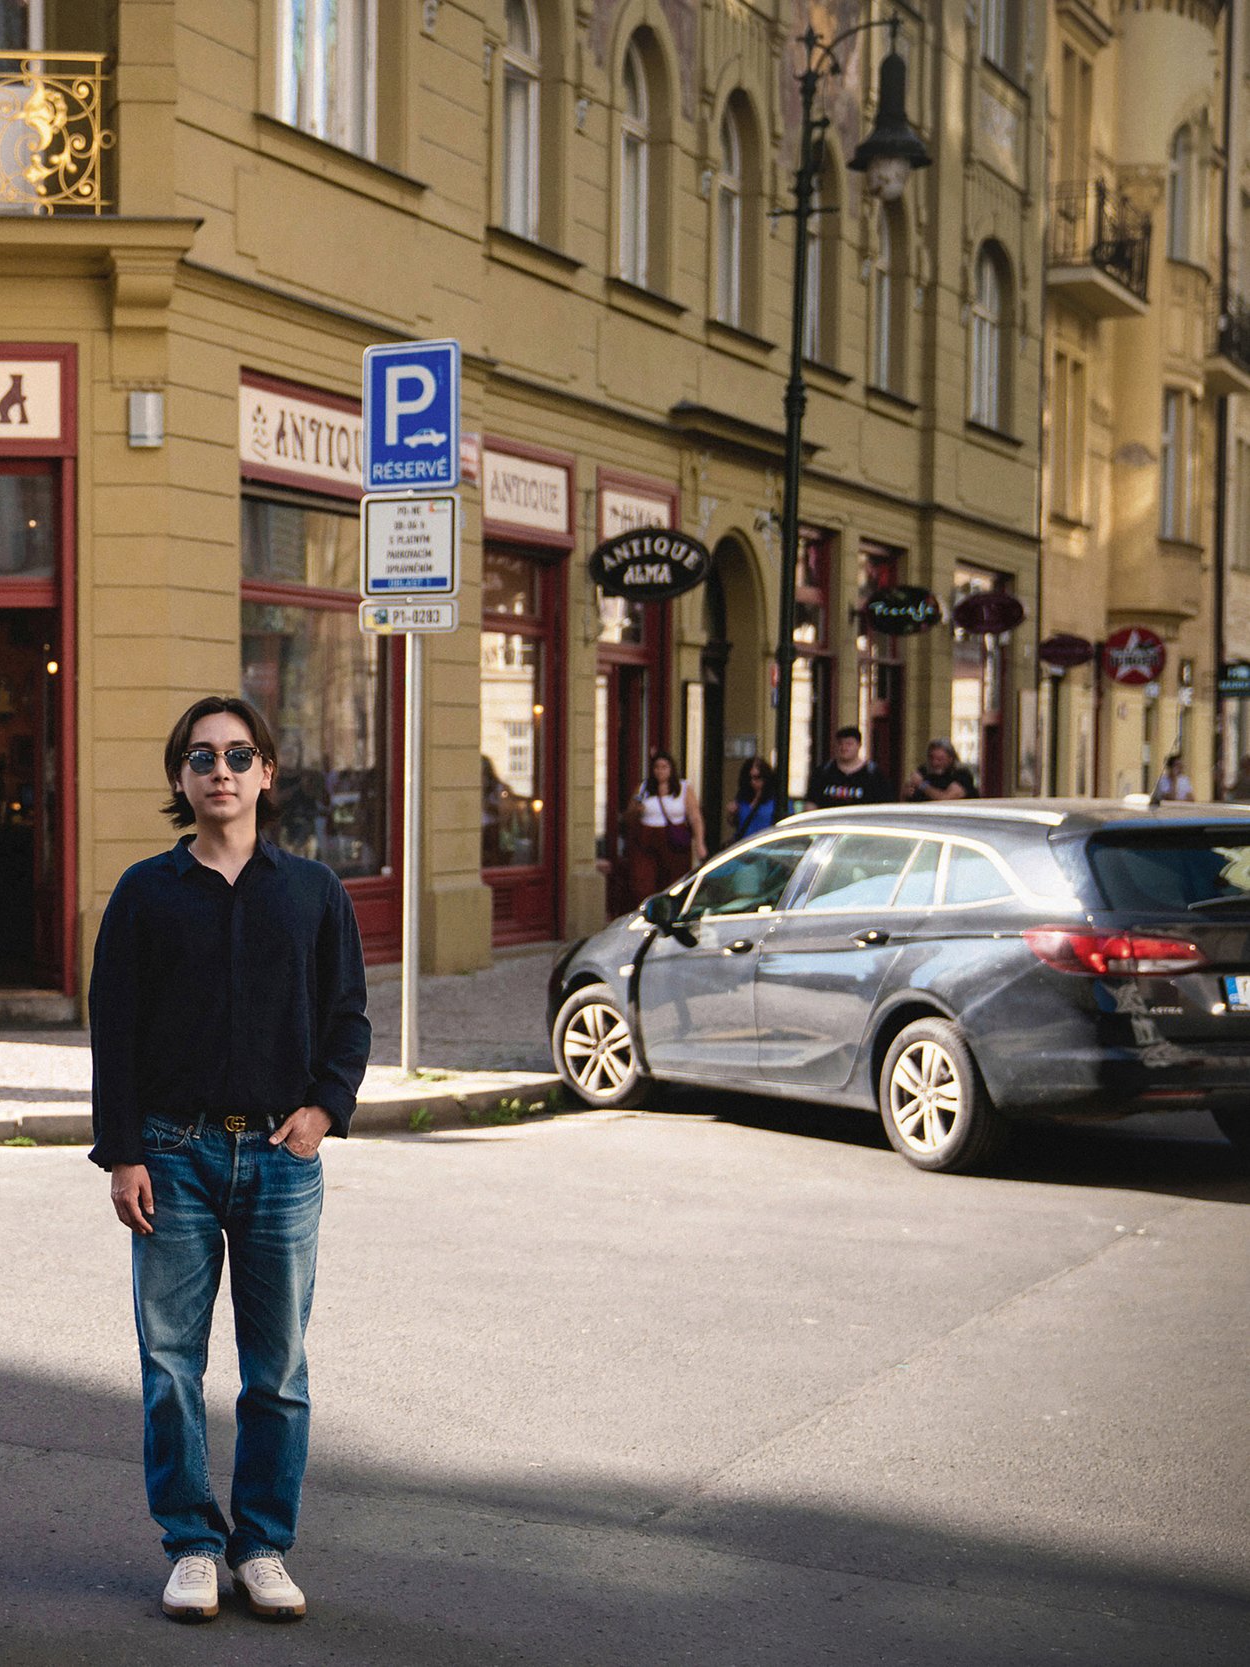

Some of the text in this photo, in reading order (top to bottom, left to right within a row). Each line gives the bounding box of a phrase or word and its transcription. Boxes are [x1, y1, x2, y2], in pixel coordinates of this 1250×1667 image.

[385, 364, 436, 446] P
[274, 409, 362, 473] ANTIQU
[372, 457, 448, 480] RÉSERVÉ
[490, 470, 559, 514] ANTIQUE
[602, 536, 700, 571] ANTIQUE
[623, 563, 672, 585] ALMA
